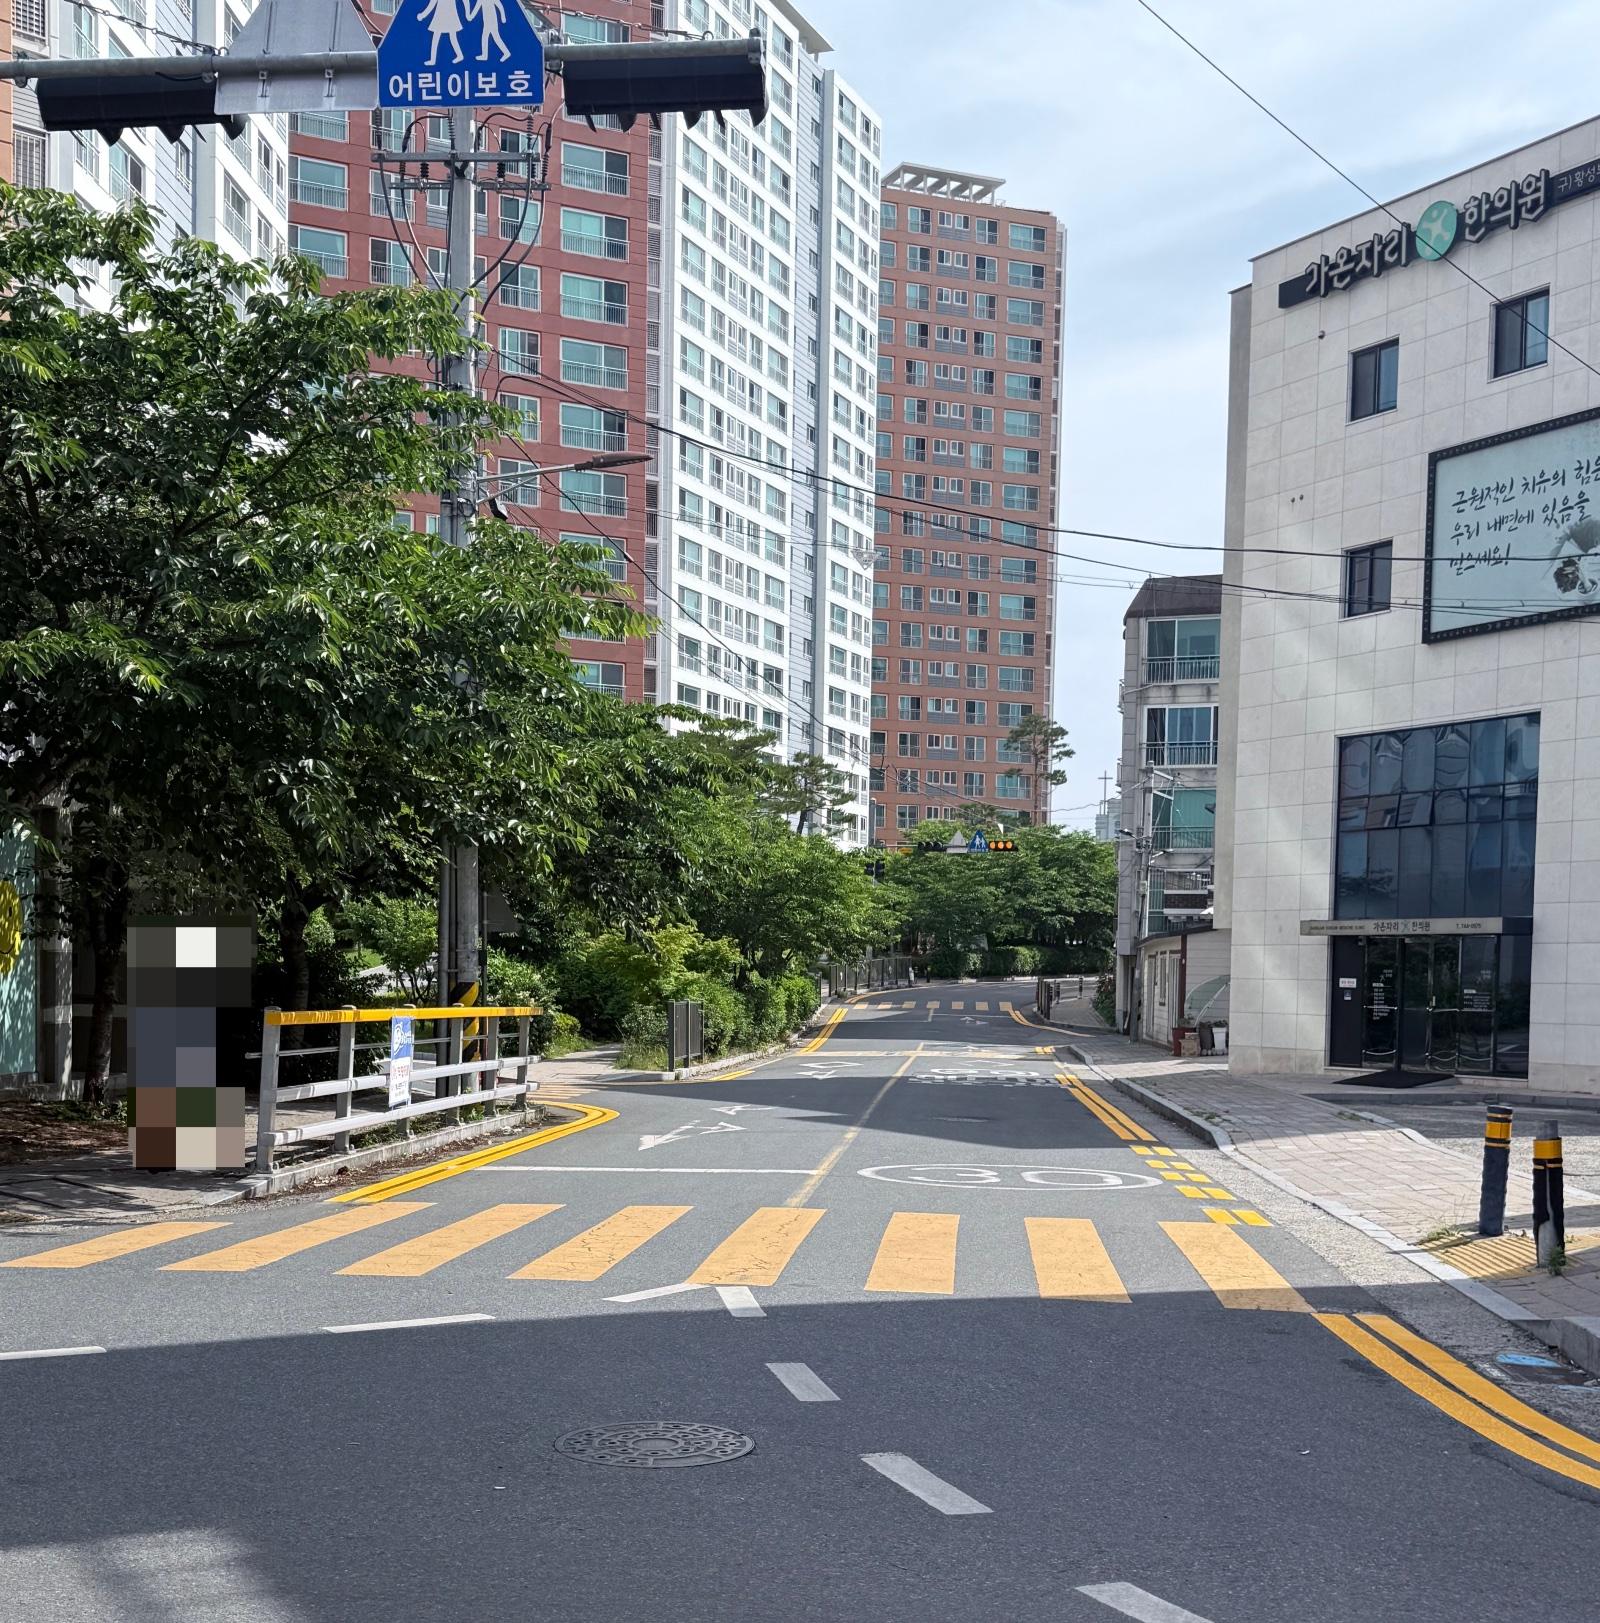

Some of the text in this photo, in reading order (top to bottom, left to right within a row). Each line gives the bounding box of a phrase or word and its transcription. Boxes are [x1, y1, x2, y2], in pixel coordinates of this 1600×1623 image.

[389, 70, 533, 101] 어린이보호
[1305, 168, 1549, 297] 가온자리 한의원
[1451, 477, 1515, 513] 근원적인
[1521, 469, 1566, 495] 치유의
[1451, 490, 1592, 546] 우리 내면에 있음을
[1373, 921, 1399, 932] 가온자리
[1411, 921, 1431, 932] 한의원
[908, 1167, 1123, 1186] 30
